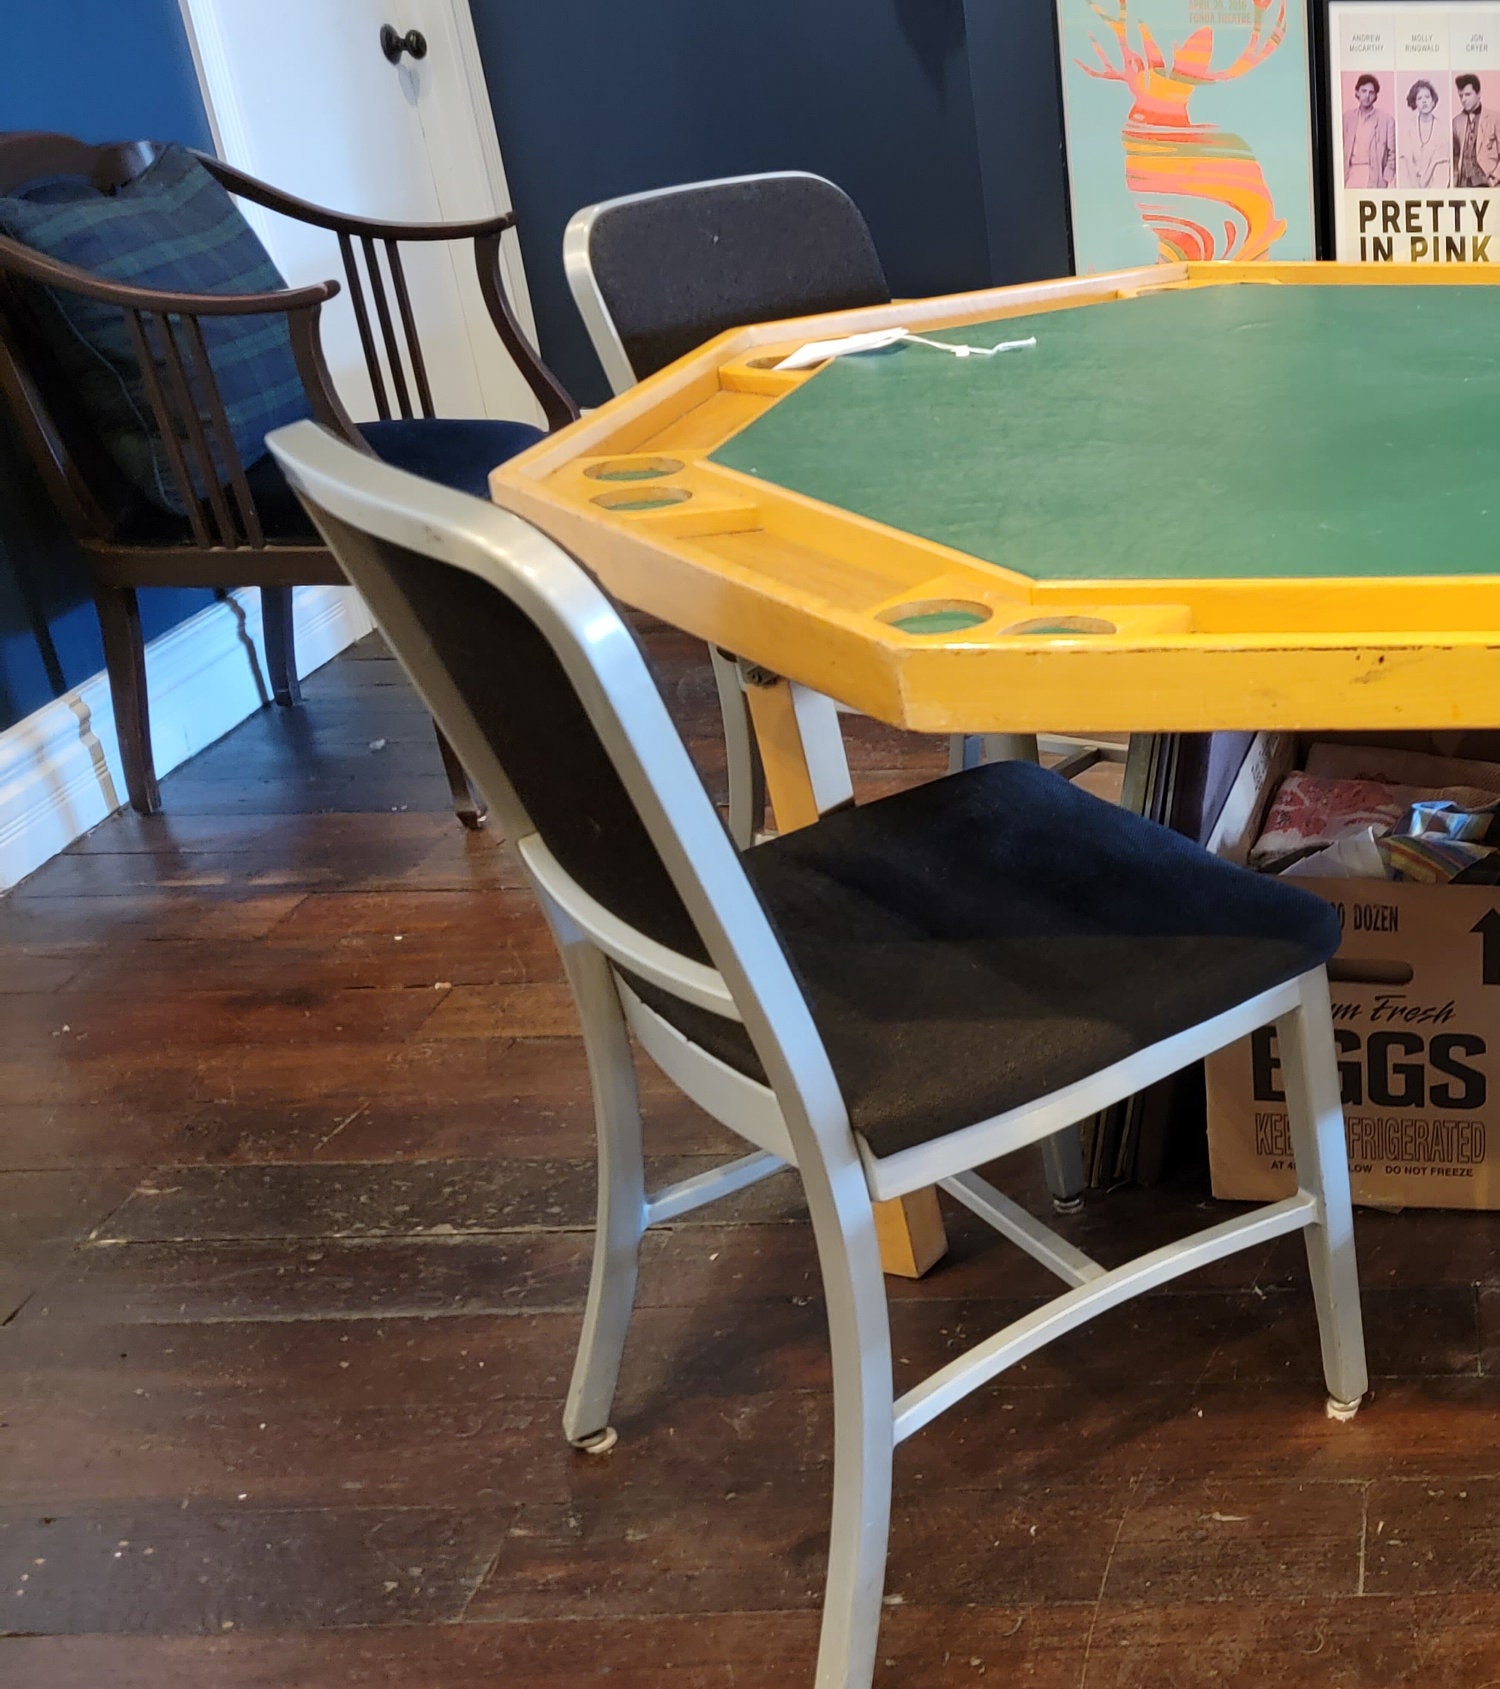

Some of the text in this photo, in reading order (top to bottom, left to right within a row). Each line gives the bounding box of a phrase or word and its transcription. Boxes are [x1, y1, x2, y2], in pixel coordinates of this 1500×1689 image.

[1352, 33, 1381, 42] ANDREW
[1411, 33, 1433, 42] MOLLY
[1470, 33, 1484, 42] JON
[1405, 44, 1440, 52] RINGWALD
[1466, 44, 1488, 52] CRYER
[1359, 199, 1490, 233] PRETTY
[1360, 235, 1492, 263] IN PINK
[1353, 904, 1399, 932] DOZEN
[1370, 994, 1456, 1023] Fresh
[1255, 1112, 1486, 1164] KEE FRIGERATED
[1271, 1160, 1284, 1170] AT
[1385, 1165, 1401, 1175] DO
[1404, 1166, 1428, 1176] NOT
[1430, 1167, 1473, 1177] FREEZE
